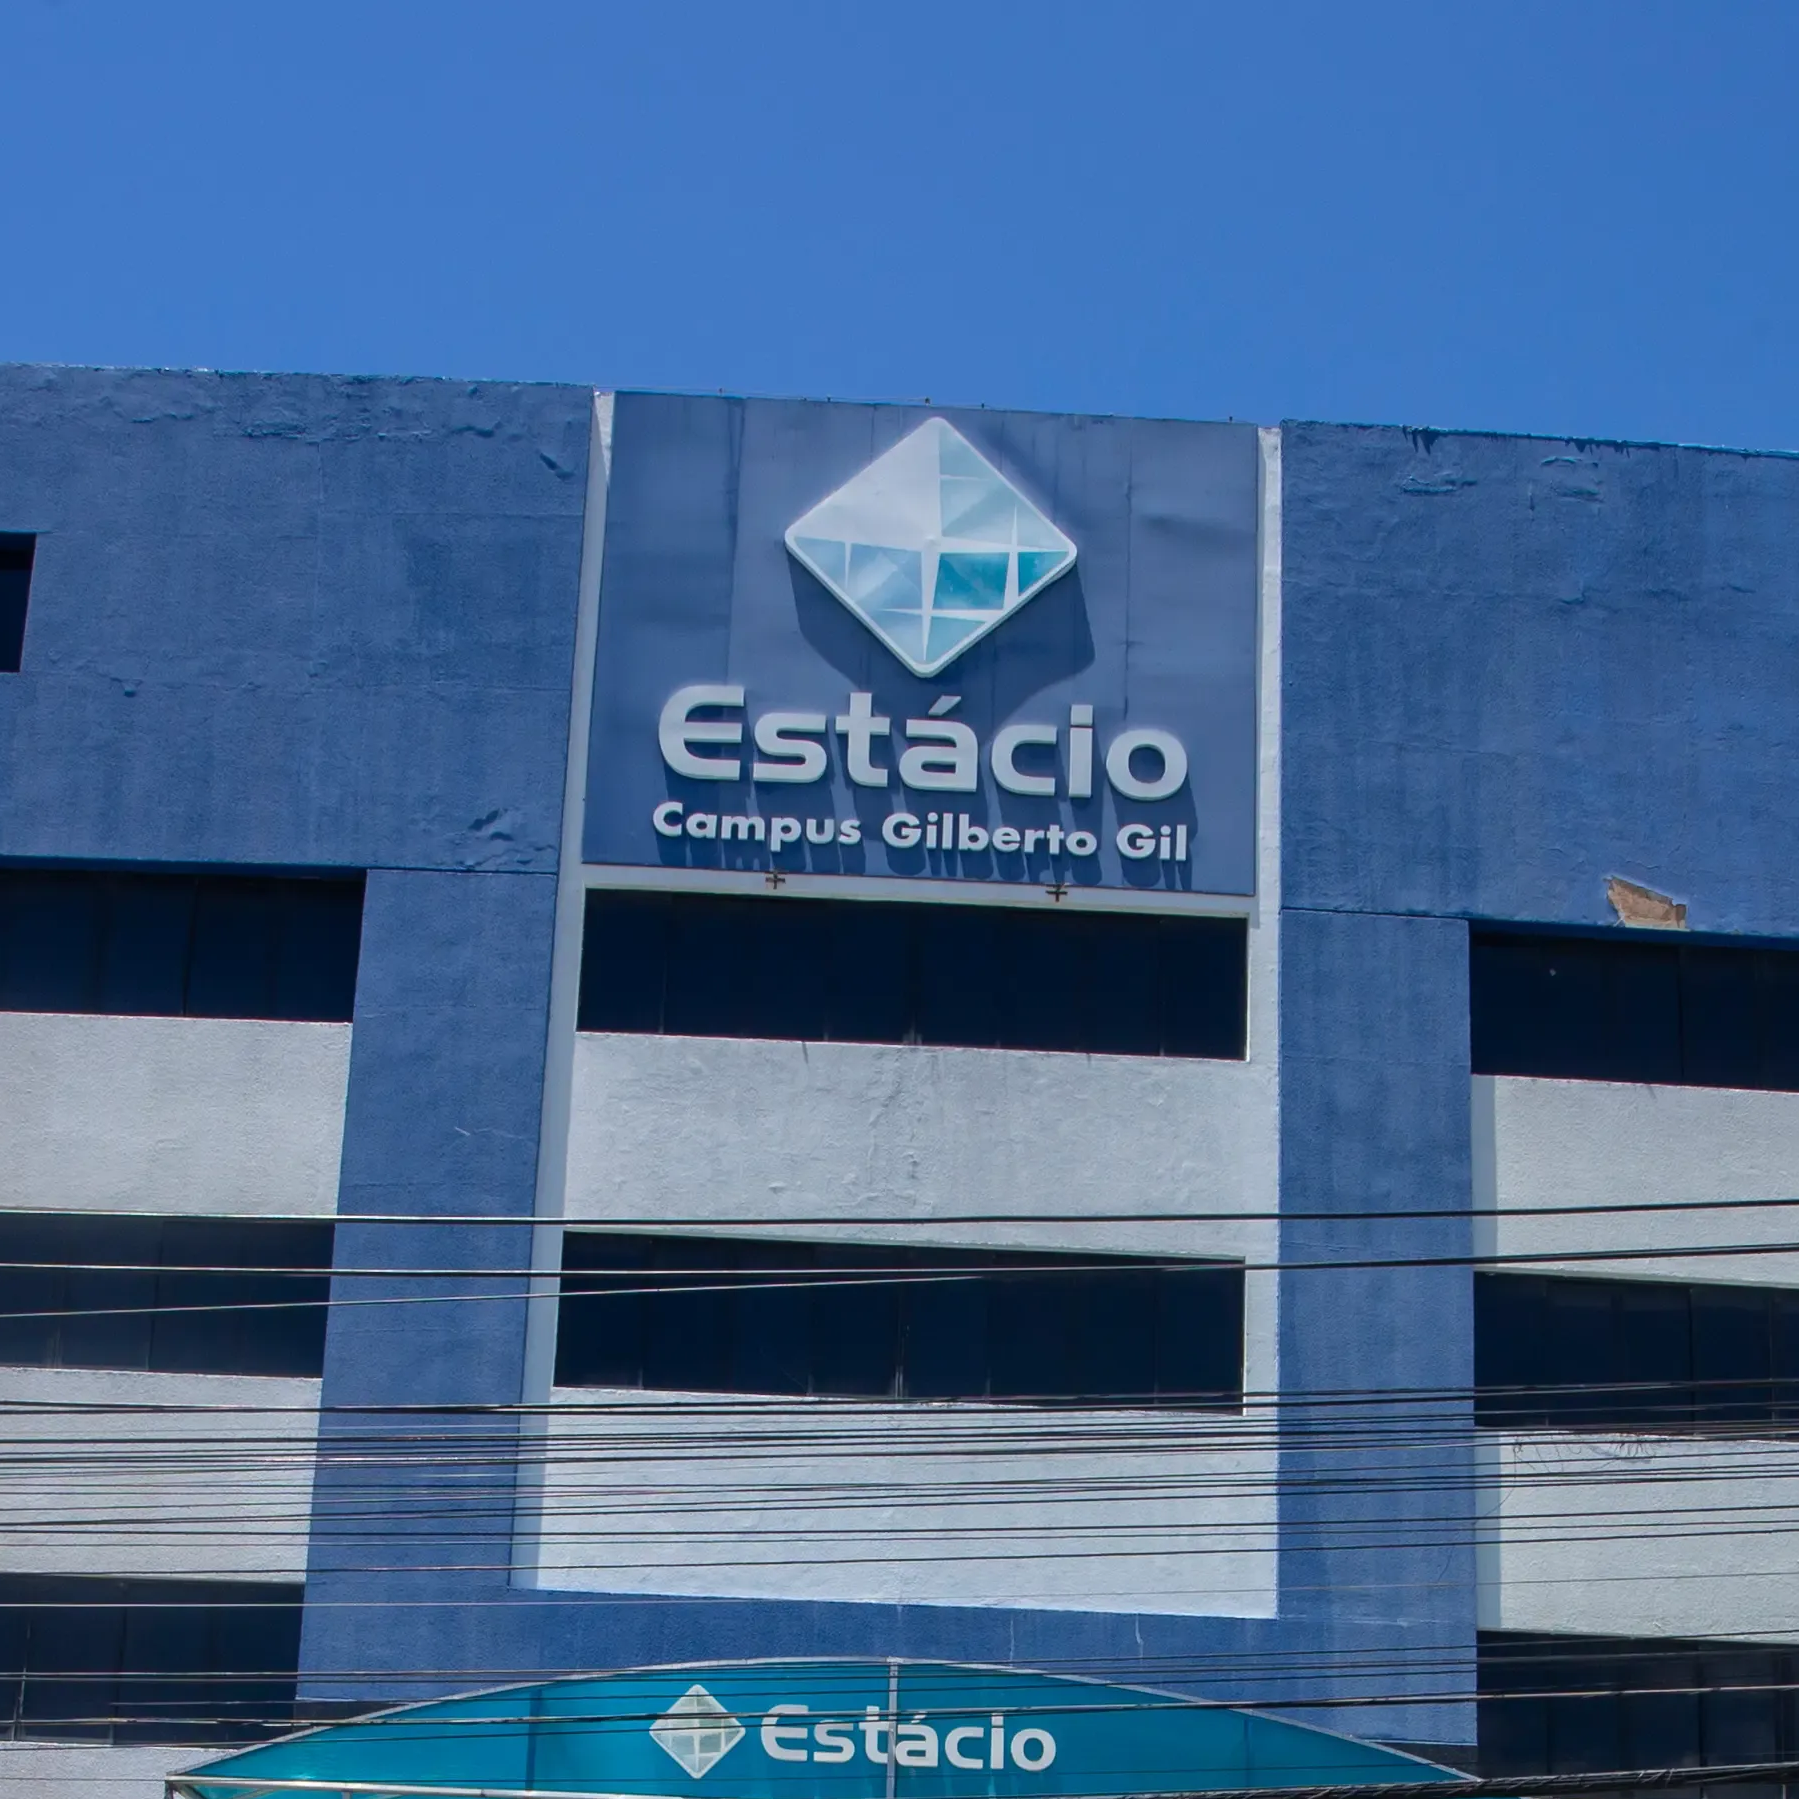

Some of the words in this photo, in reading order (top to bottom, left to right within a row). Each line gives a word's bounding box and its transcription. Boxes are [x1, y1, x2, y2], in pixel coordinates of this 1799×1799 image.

[658, 684, 1188, 801] Estácio
[652, 801, 862, 853] Campus
[882, 812, 1098, 857] Gilberto
[1115, 823, 1188, 862] Gil
[759, 1703, 1058, 1772] Estácio
